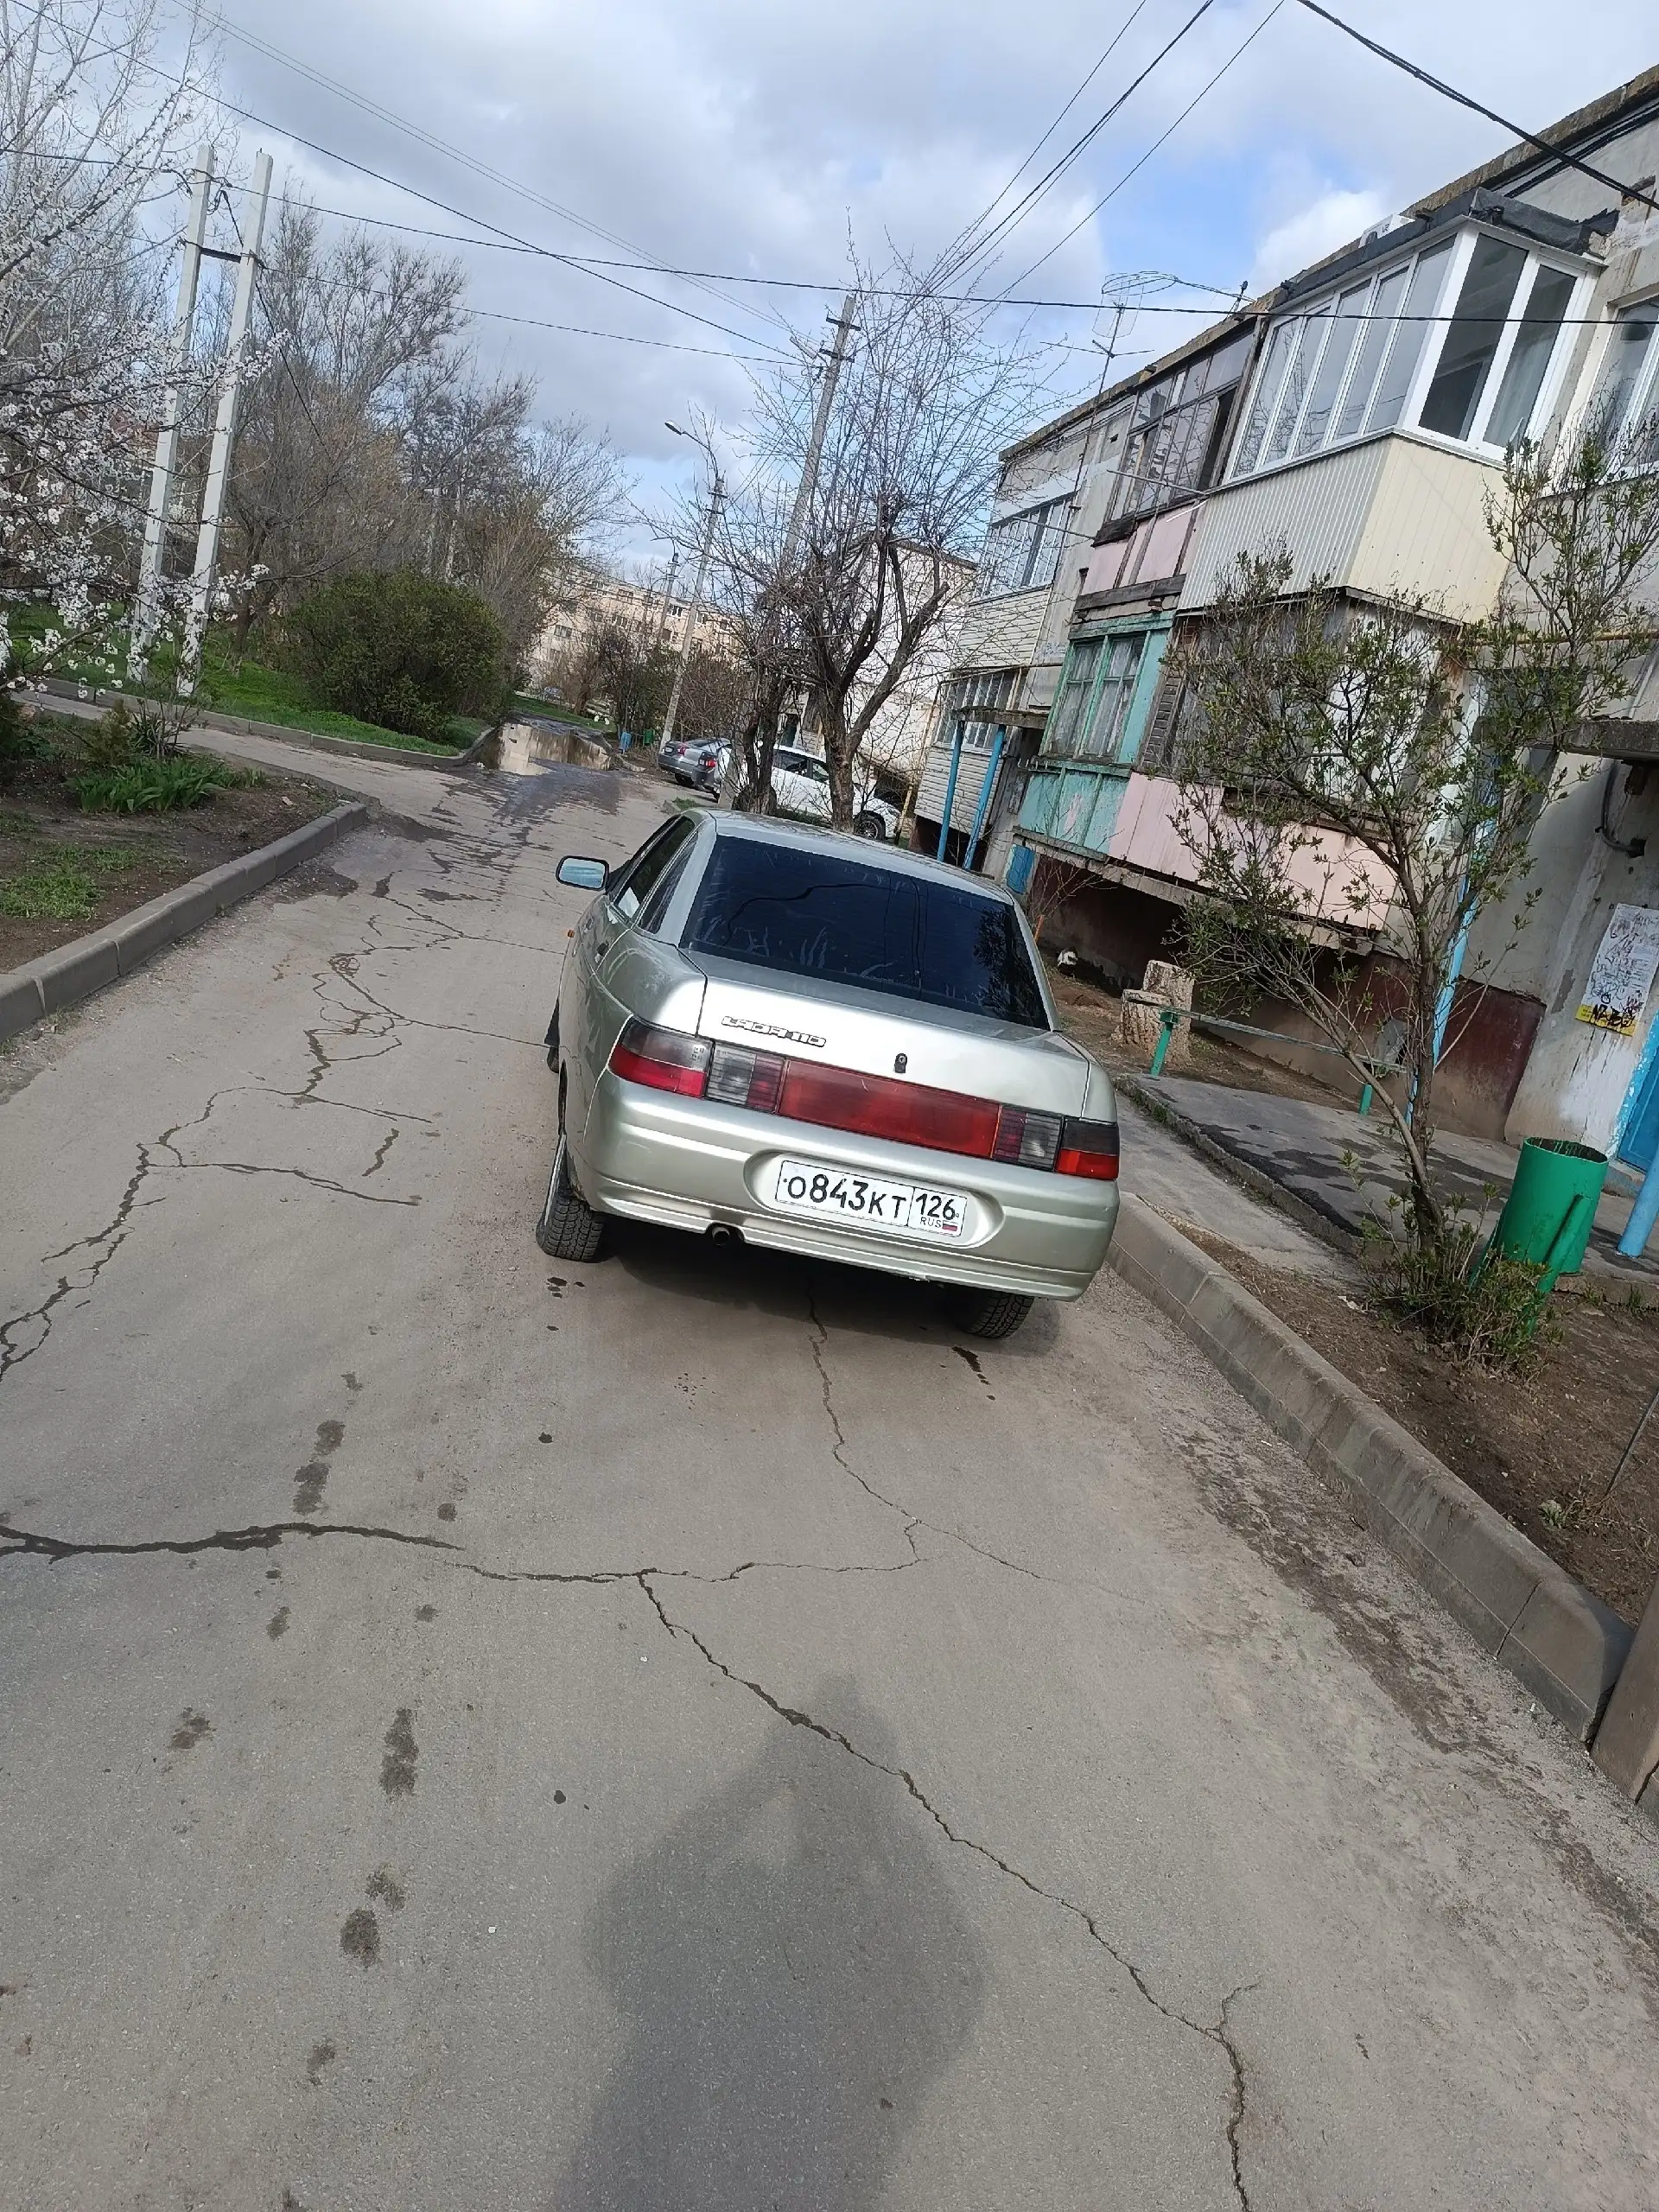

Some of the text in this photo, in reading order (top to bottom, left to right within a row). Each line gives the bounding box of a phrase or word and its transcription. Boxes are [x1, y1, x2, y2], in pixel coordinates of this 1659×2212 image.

[721, 1016, 827, 1047] LADA 110
[916, 1193, 956, 1220] 126
[920, 1217, 942, 1229] RUS
